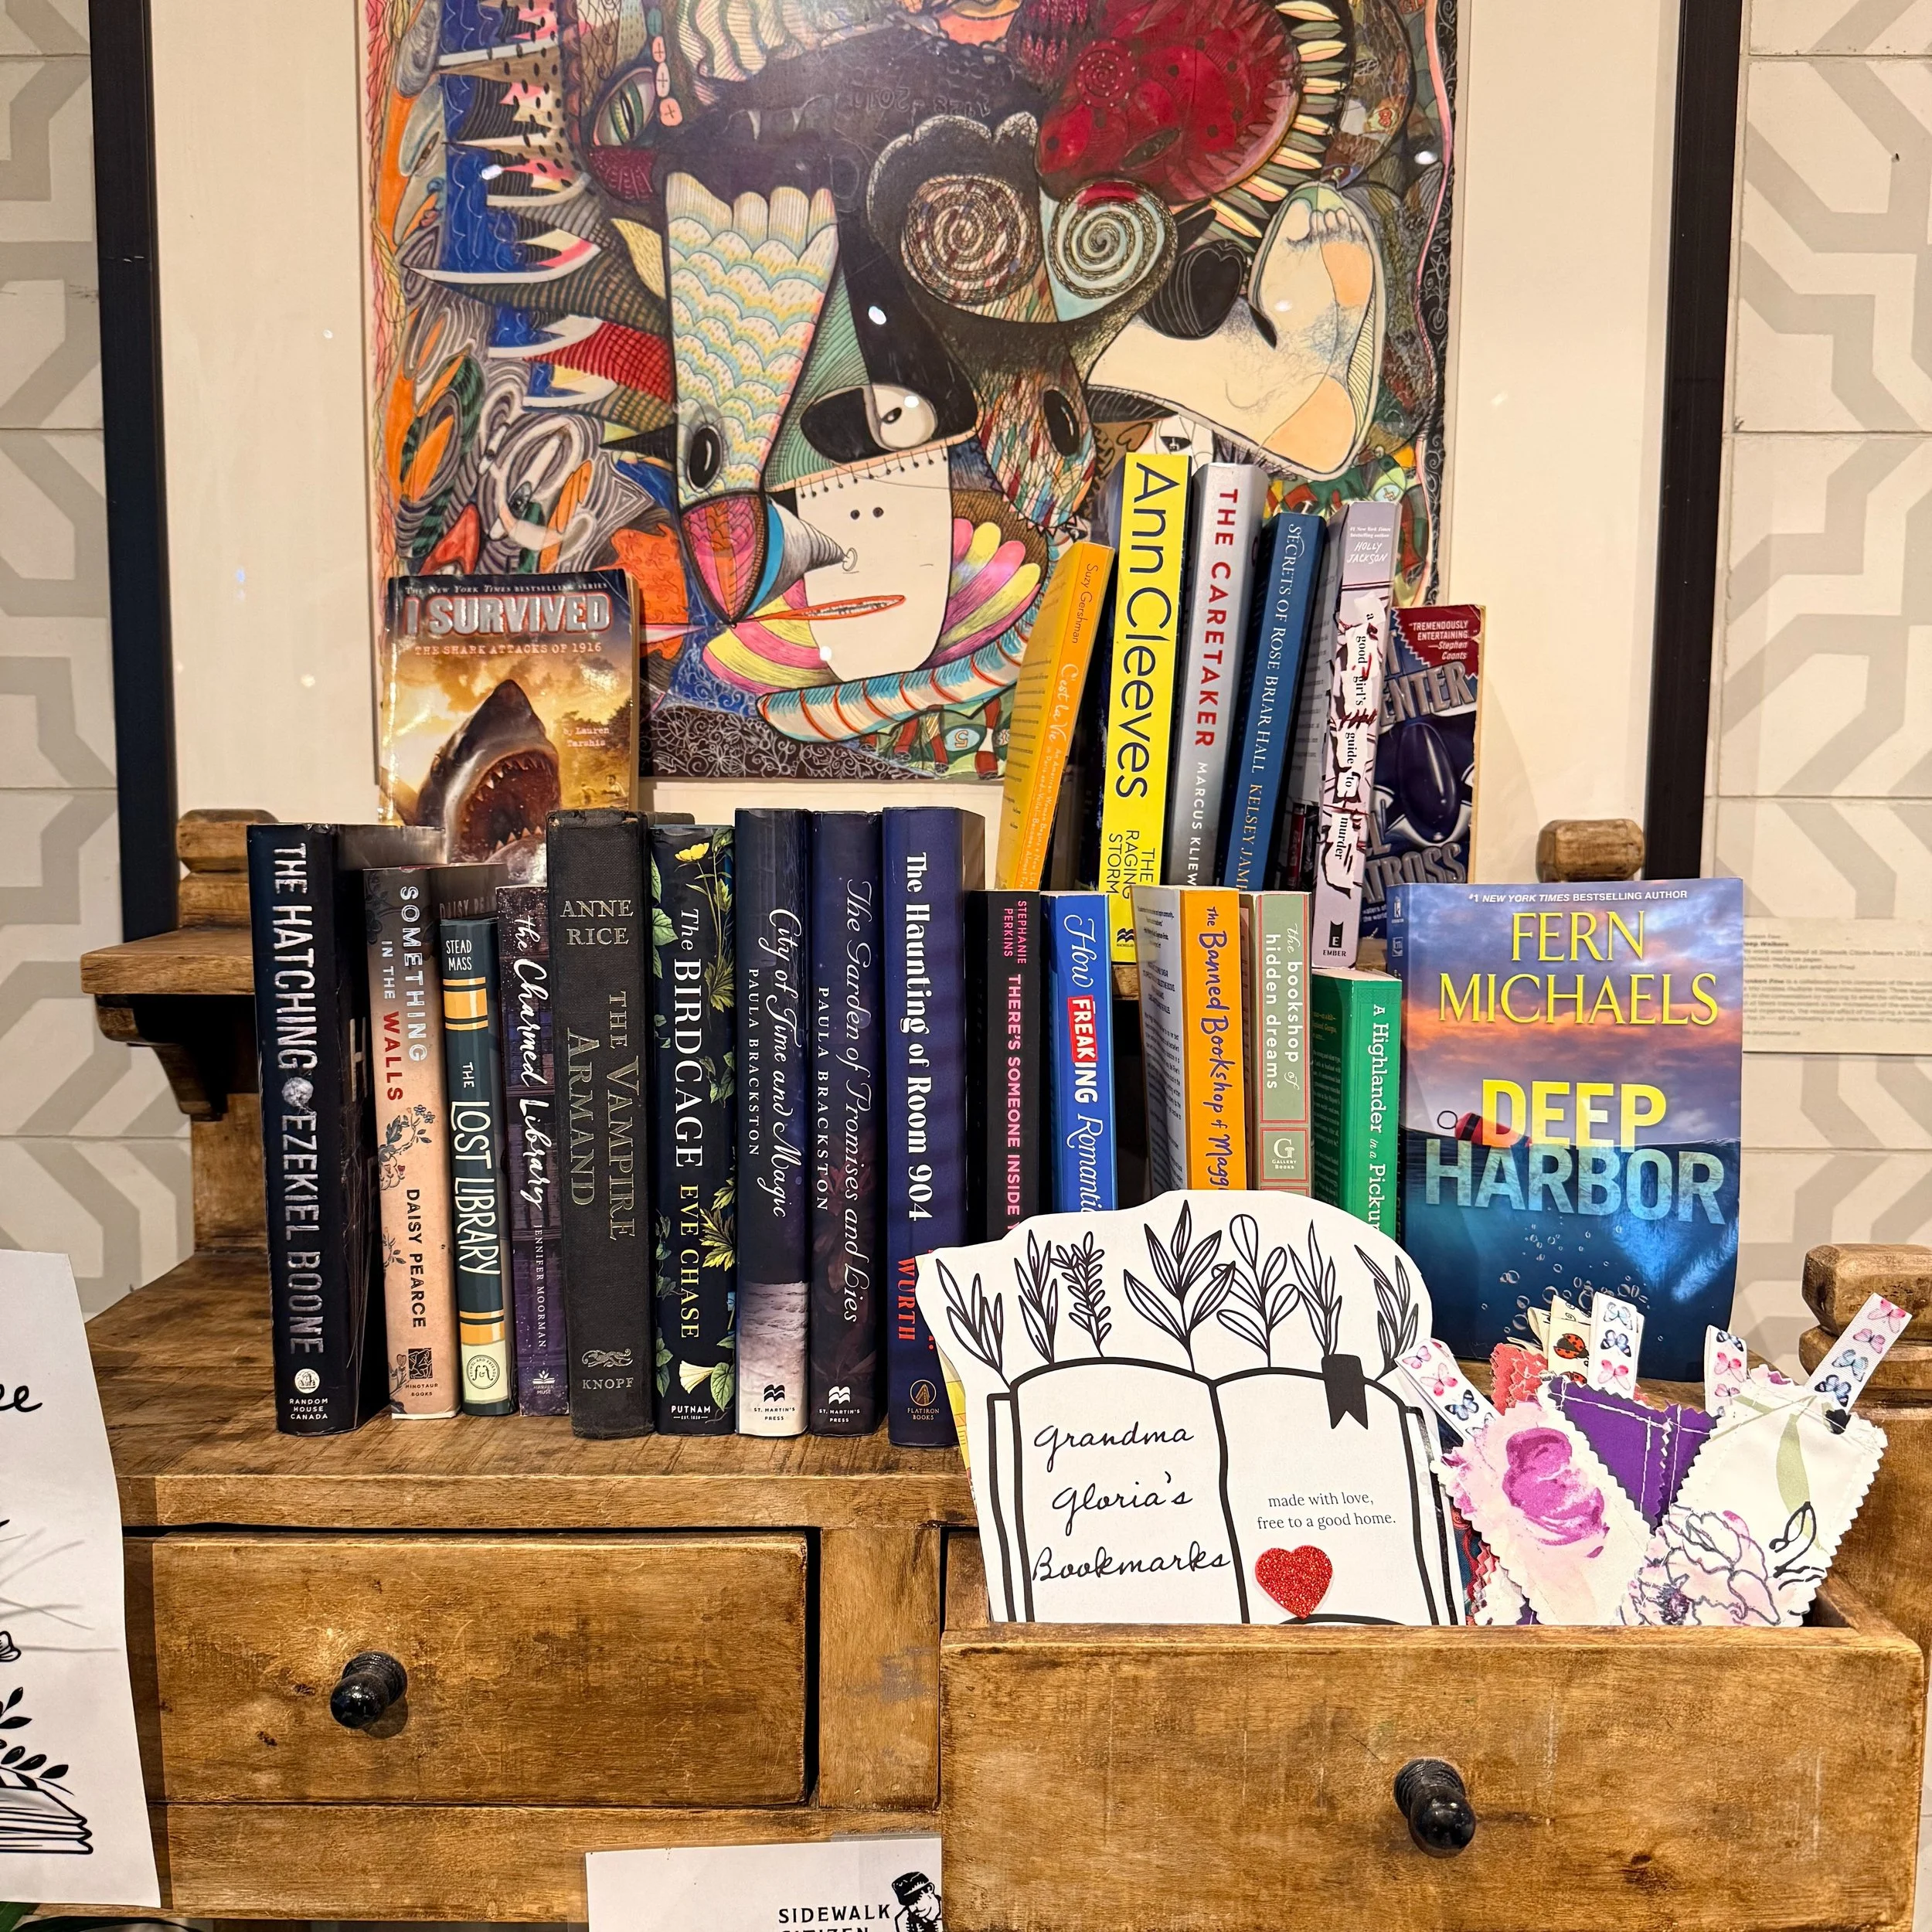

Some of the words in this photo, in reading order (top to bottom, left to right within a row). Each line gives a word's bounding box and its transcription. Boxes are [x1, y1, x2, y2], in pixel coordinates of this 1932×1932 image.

[1129, 461, 1181, 573] Ann
[1214, 488, 1238, 546] THE
[1279, 523, 1305, 596] SECRETS
[1347, 553, 1388, 564] JACKSON
[1354, 541, 1383, 553] HOLLY
[454, 584, 479, 593] YORK
[483, 583, 511, 593] TIMES
[514, 583, 574, 592] BESTSELLING
[1079, 563, 1099, 590] Suzy
[406, 596, 420, 635] I
[428, 592, 612, 635] SURVIVED
[1071, 590, 1093, 645] Gershman
[1276, 600, 1289, 623] OF
[414, 646, 440, 655] THE
[444, 645, 486, 655] SHARK
[490, 644, 548, 655] ATTACKS
[551, 644, 567, 654] OF
[572, 641, 602, 653] 1916
[1194, 562, 1232, 747] CARETAKER
[1267, 627, 1286, 670] ROSE
[1356, 635, 1368, 664] good
[1441, 651, 1468, 661] Coonts
[1053, 704, 1070, 722] la
[1115, 587, 1172, 799] Cleeves
[1257, 675, 1279, 726] BRIAR
[1353, 675, 1366, 706] girl's
[575, 726, 610, 734] Lauren
[1251, 730, 1270, 774] HALL
[1345, 732, 1358, 764] guide
[1192, 761, 1209, 830] MARCUS
[1345, 776, 1353, 787] to
[1242, 783, 1263, 845] KELSEY
[1335, 817, 1349, 861] murder
[274, 842, 307, 894] THE
[906, 851, 927, 893] The
[1106, 833, 1121, 895] STORM
[1123, 829, 1140, 900] RAGING
[1139, 847, 1155, 883] THE
[560, 899, 634, 918] ANNE
[846, 879, 872, 932] The
[1206, 906, 1219, 927] The
[1468, 893, 1479, 903] #1
[1482, 894, 1507, 903] NEW
[1508, 893, 1536, 903] YORK
[1539, 893, 1570, 903] TIMES
[1573, 892, 1642, 902] BESTSELLING
[1645, 890, 1689, 900] AUTHOR
[381, 940, 393, 957] IN
[445, 939, 472, 955] STEAD
[513, 914, 541, 952] the
[566, 927, 630, 947] RICE
[680, 906, 700, 952] The
[758, 907, 802, 961] City
[1004, 908, 1013, 957] PERKINS
[1018, 900, 1027, 964] STEPHANIE
[1063, 914, 1098, 988] How
[1287, 923, 1301, 954] the
[1511, 910, 1645, 962] FERN
[272, 905, 318, 1070] HATCHING
[383, 965, 396, 999] THE
[400, 886, 428, 1062] SOMETHING
[448, 957, 472, 971] MASS
[775, 969, 799, 999] of
[846, 939, 872, 1040] Garden
[899, 903, 933, 1035] Haunting
[1199, 930, 1230, 1011] Banned
[1265, 934, 1281, 1005] hidden
[513, 957, 549, 1087] Charmed
[609, 991, 628, 1049] THE
[748, 968, 760, 1029] PAULA
[818, 987, 829, 1058] PAULA
[1008, 974, 1022, 1051] THERE'S
[1284, 961, 1303, 1063] bookshop
[1373, 1004, 1386, 1016] A
[1438, 972, 1719, 1026] MICHAELS
[383, 1011, 403, 1101] WALLS
[765, 994, 802, 1063] Time
[908, 1043, 930, 1068] of
[1070, 997, 1098, 1104] FREAKING
[1266, 1015, 1281, 1089] dreams
[462, 1062, 475, 1088] THE
[673, 957, 705, 1168] BIRDCAGE
[835, 1046, 871, 1078] of
[1201, 1015, 1236, 1114] Bookshop
[1284, 1070, 1300, 1091] of
[1367, 1022, 1389, 1134] Highlander
[566, 1027, 600, 1206] ARMAND
[748, 1038, 760, 1156] BRACKSTON
[772, 1070, 794, 1117] and
[907, 1076, 932, 1154] Room
[1008, 1056, 1021, 1148] SOMEONE
[1481, 1079, 1667, 1153] DEEP
[450, 1100, 492, 1170] LOST
[607, 1055, 640, 1241] VAMPIRE
[817, 1070, 829, 1210] BRACKSTON
[845, 1079, 872, 1201] Promises
[1210, 1118, 1228, 1129] of
[1370, 1138, 1379, 1150] in
[281, 1111, 321, 1241] EZEKIEL
[519, 1098, 553, 1212] Library
[757, 1121, 802, 1218] Magic
[1369, 1151, 1377, 1159] a
[1425, 1138, 1726, 1226] HARBOR
[680, 1183, 699, 1236] EVE
[908, 1164, 934, 1222] 904
[1007, 1155, 1020, 1216] INSIDE
[406, 1189, 422, 1245] DAISY
[454, 1177, 501, 1275] LIBRARY
[845, 1208, 869, 1264] and
[533, 1224, 545, 1281] JENNIFER
[287, 1250, 325, 1355] BOONE
[409, 1253, 427, 1328] PEARCE
[536, 1286, 546, 1348] MOORMAN
[680, 1249, 700, 1339] CHASE
[844, 1262, 870, 1323] Lies
[898, 1257, 916, 1341] WURTH
[289, 1397, 329, 1406] RANDOM
[582, 1377, 634, 1390] KNOPF
[671, 1404, 711, 1414] PUTNAM
[1033, 1420, 1195, 1473] Grandma
[1052, 1471, 1193, 1536] Gloria's
[1257, 1517, 1284, 1529] free
[1287, 1517, 1302, 1528] to
[1306, 1518, 1314, 1527] a
[1318, 1513, 1351, 1531] good
[1354, 1512, 1396, 1526] home.
[1268, 1494, 1305, 1507] made
[1308, 1492, 1339, 1505] with
[1342, 1492, 1374, 1505] love,
[1032, 1540, 1231, 1581] Bookmarks
[778, 1904, 890, 1923] SIDEWALK
